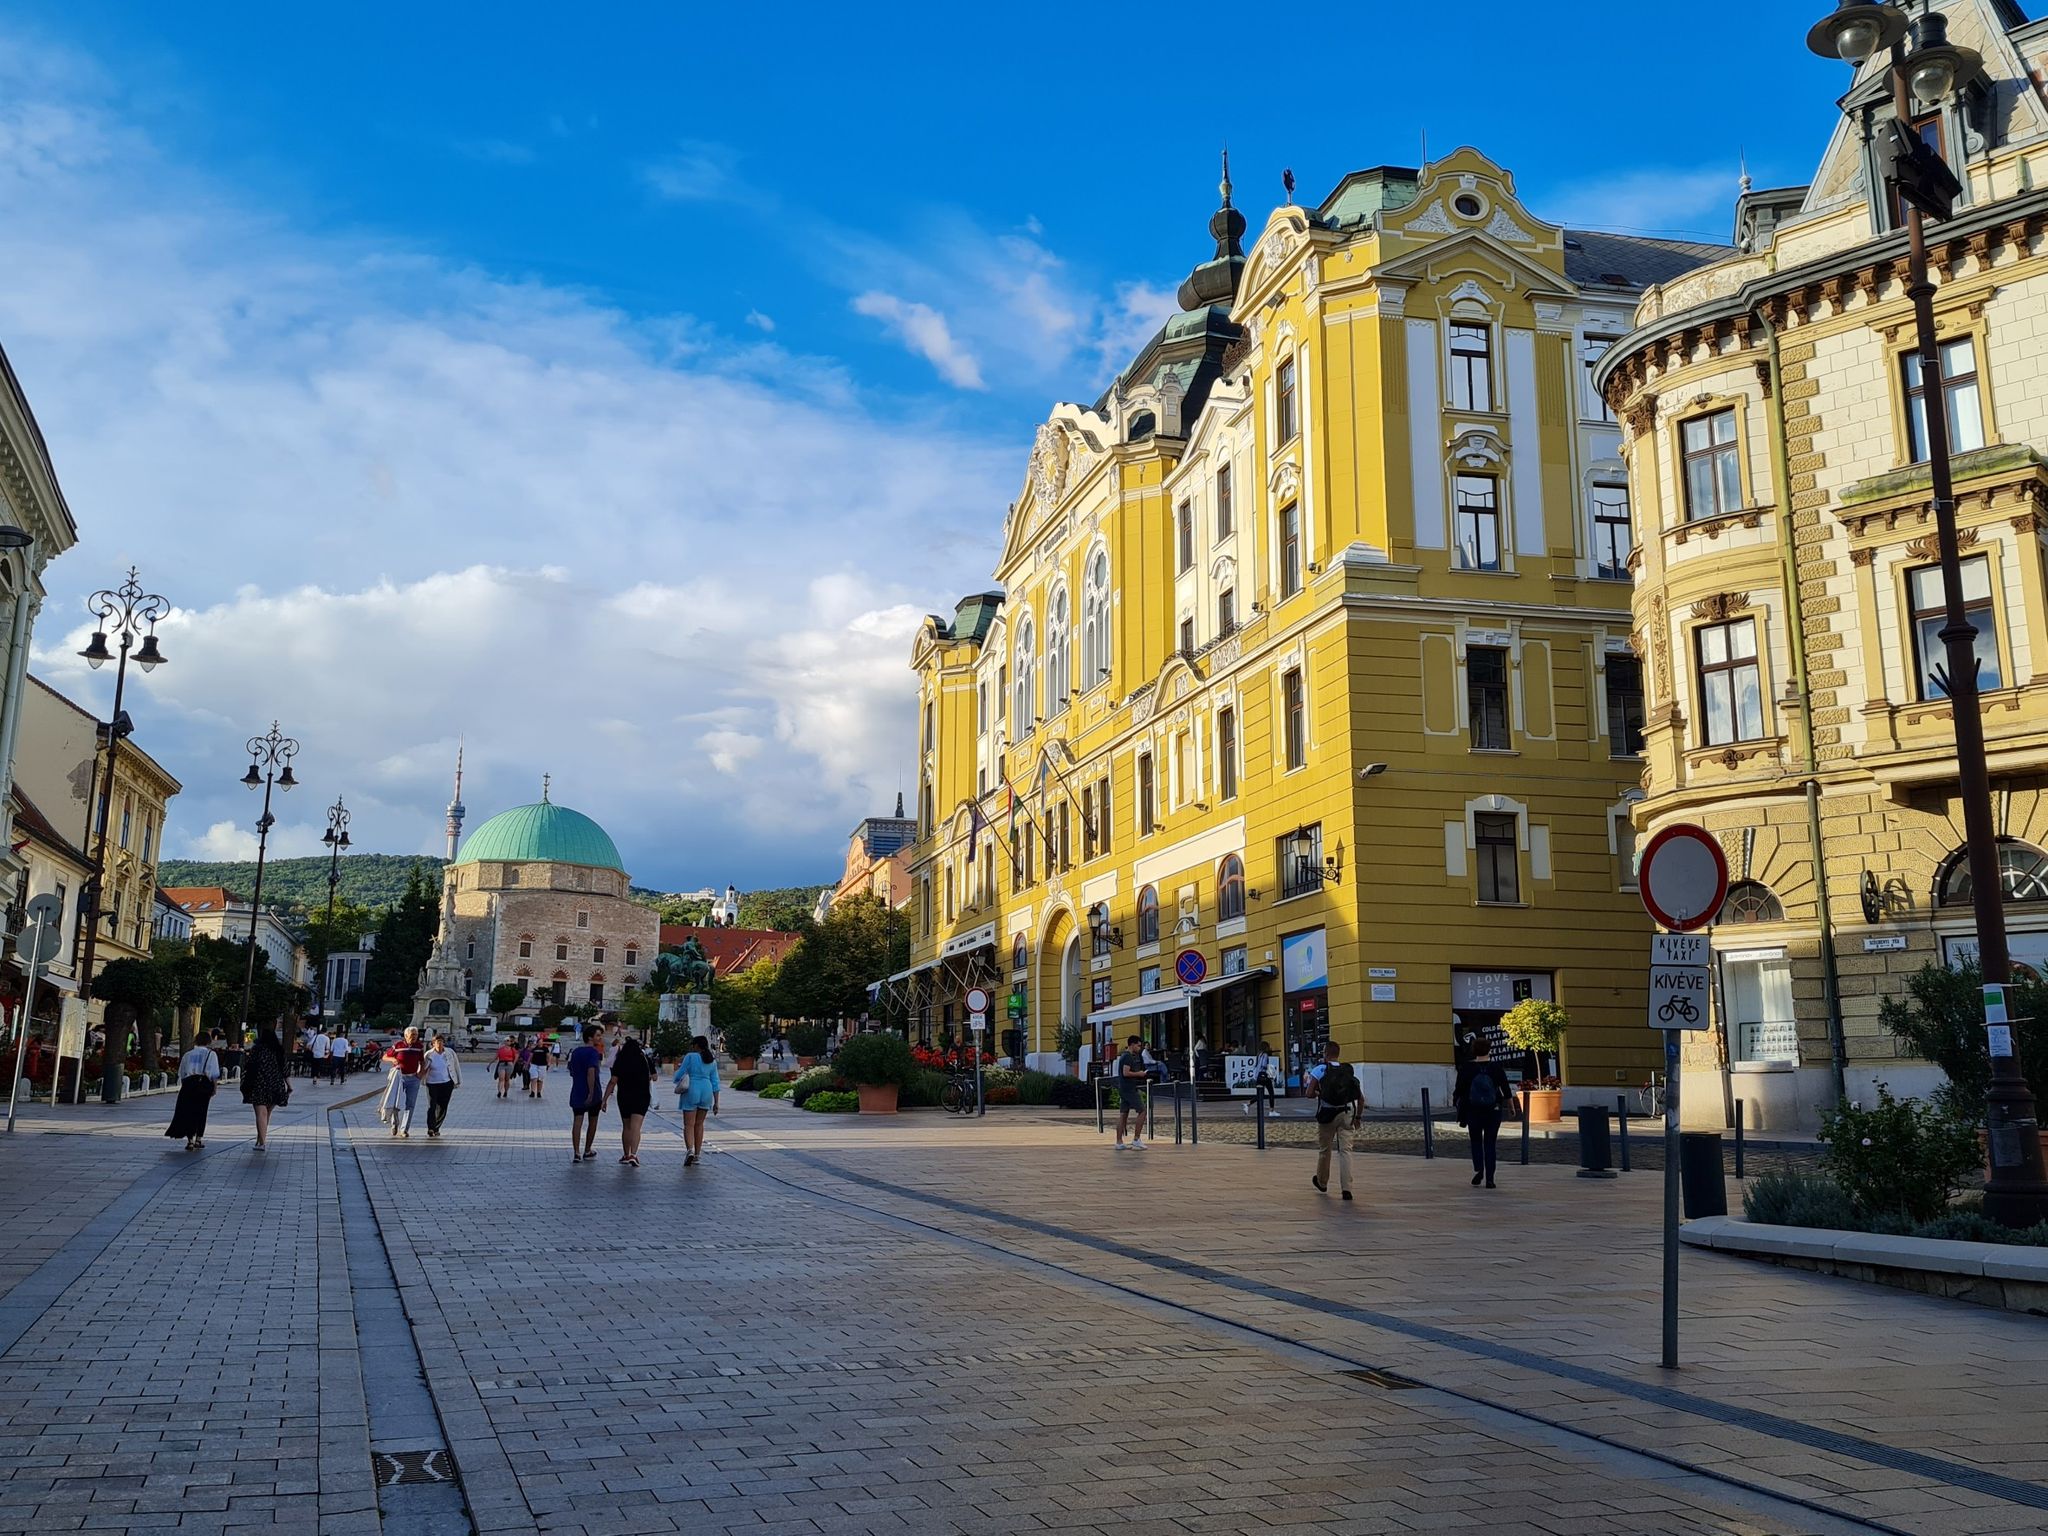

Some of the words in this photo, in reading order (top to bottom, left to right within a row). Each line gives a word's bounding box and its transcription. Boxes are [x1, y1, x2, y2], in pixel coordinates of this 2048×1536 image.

[1660, 937, 1700, 949] KIVÉVE
[1467, 977, 1471, 986] I
[1477, 973, 1509, 985] LOVE
[1655, 971, 1704, 990] KIVÉVE
[1468, 985, 1501, 999] PÉCS
[1485, 1032, 1501, 1040] FLAT
[1232, 1060, 1236, 1069] I
[1241, 1058, 1255, 1068] LO
[1232, 1068, 1255, 1080] PÉC
